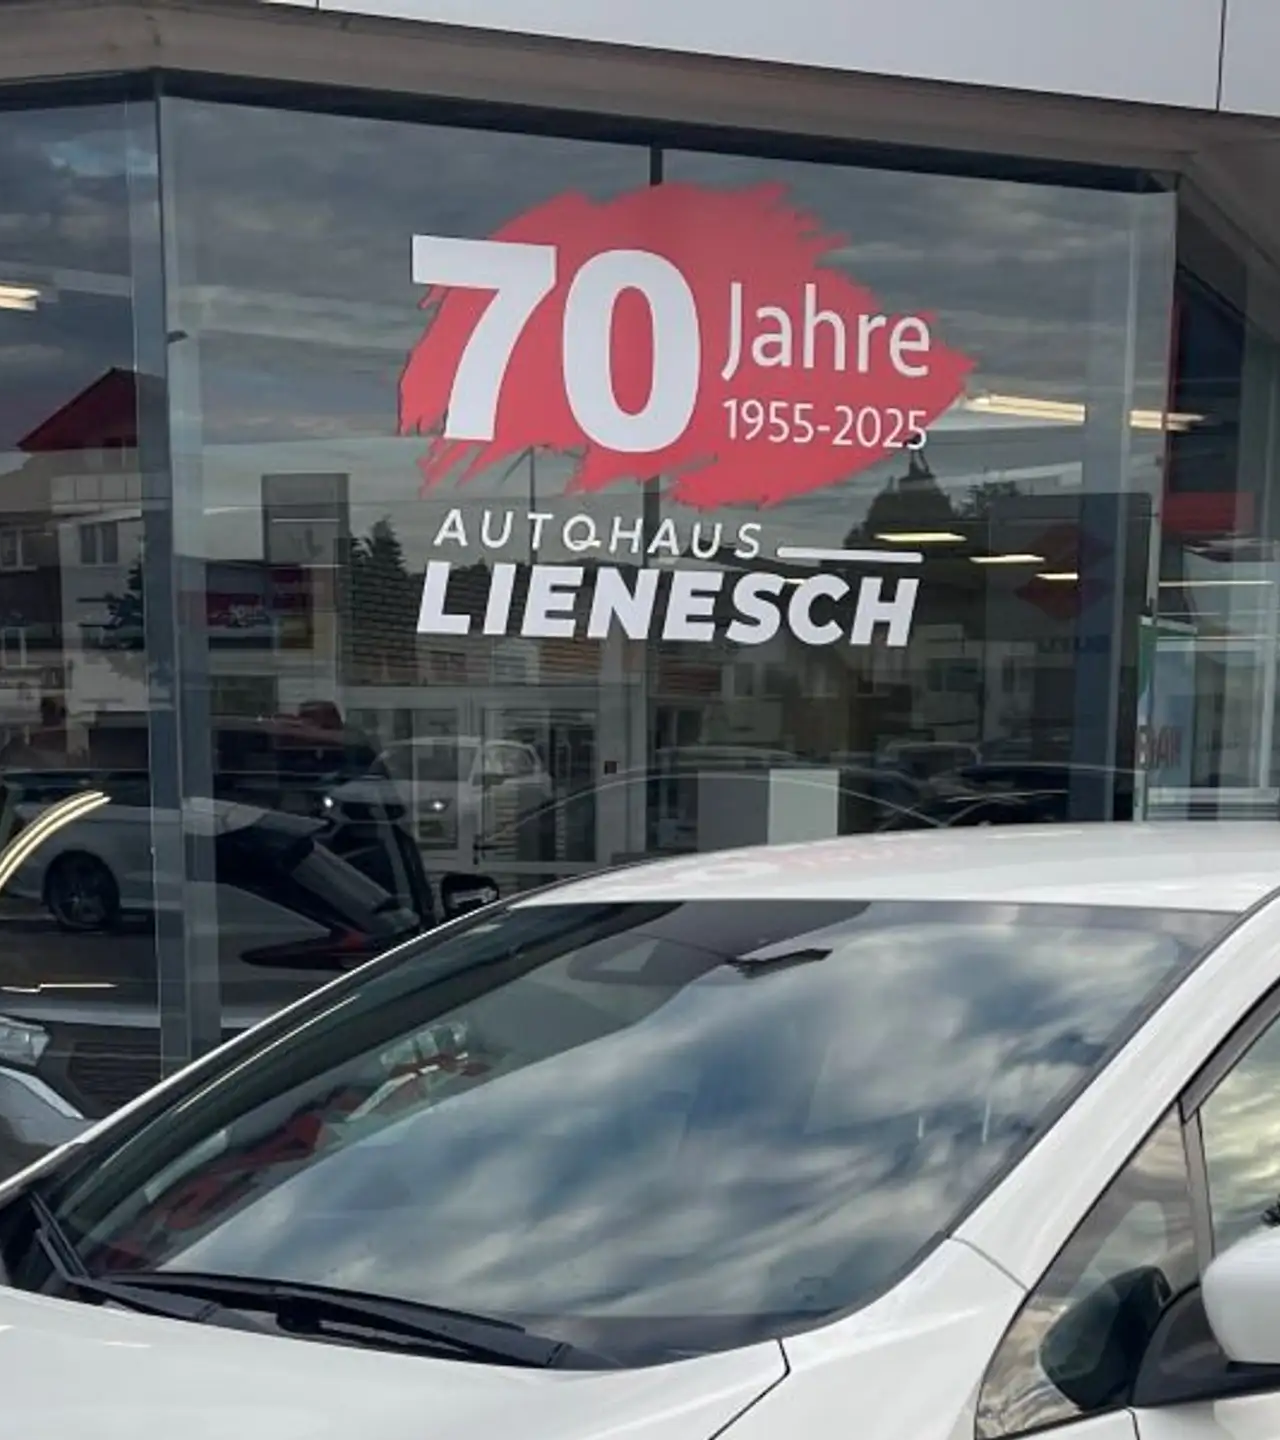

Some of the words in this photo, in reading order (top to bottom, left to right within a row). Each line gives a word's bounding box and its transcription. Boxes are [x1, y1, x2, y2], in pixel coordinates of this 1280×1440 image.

[411, 234, 701, 453] 70
[720, 282, 930, 380] Jahre
[722, 397, 929, 450] 1955-2025
[433, 507, 763, 560] AUTOHAUS
[416, 561, 921, 648] LIENESCH
